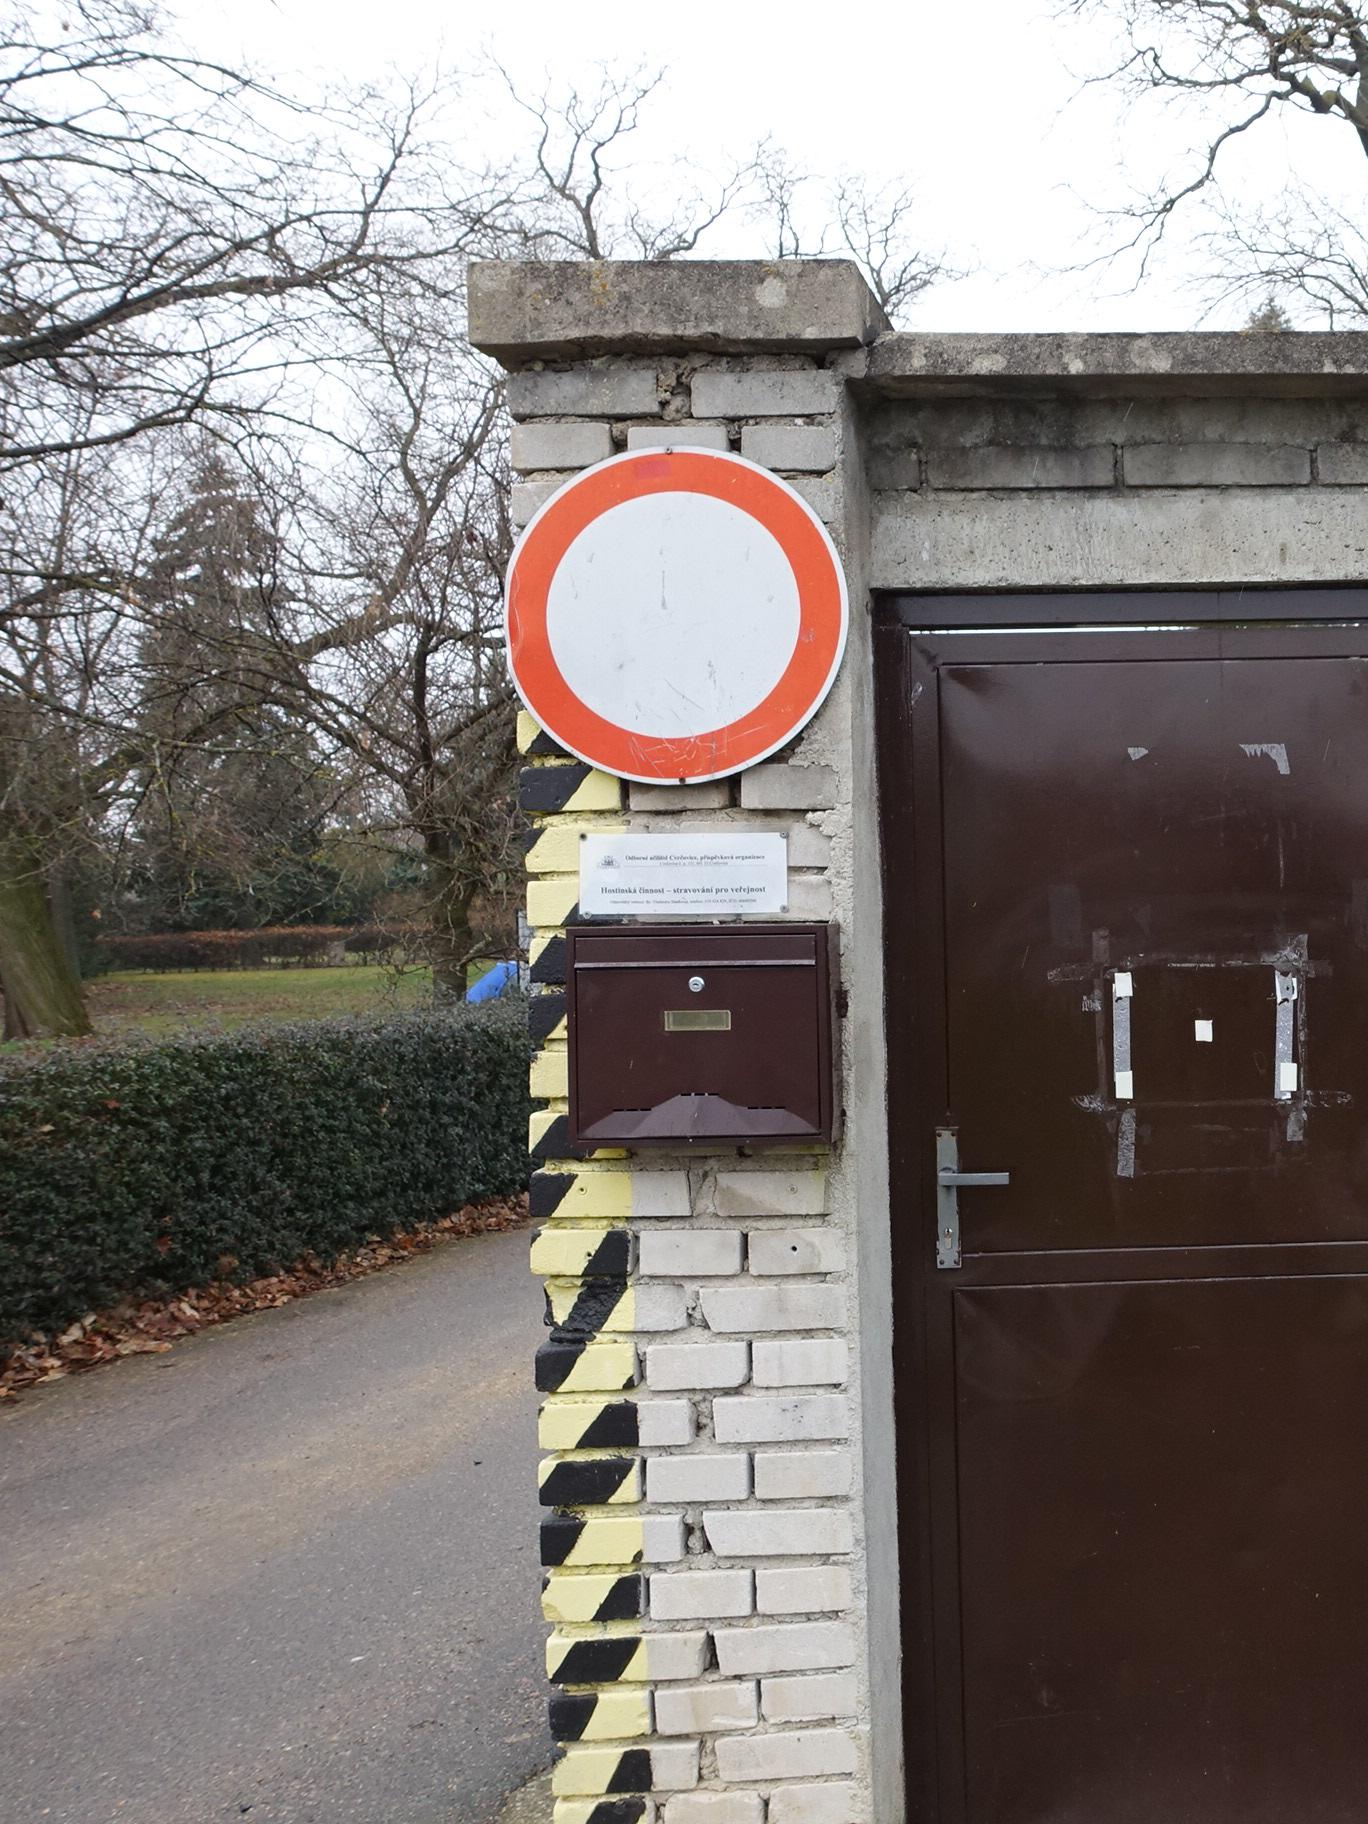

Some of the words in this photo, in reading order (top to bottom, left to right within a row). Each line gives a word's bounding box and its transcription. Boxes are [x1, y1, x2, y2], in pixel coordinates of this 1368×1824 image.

[601, 886, 637, 894] Hostinská
[638, 886, 665, 894] činnost
[673, 886, 713, 894] stravování
[715, 886, 729, 896] pro
[730, 885, 766, 895] veřejnost
